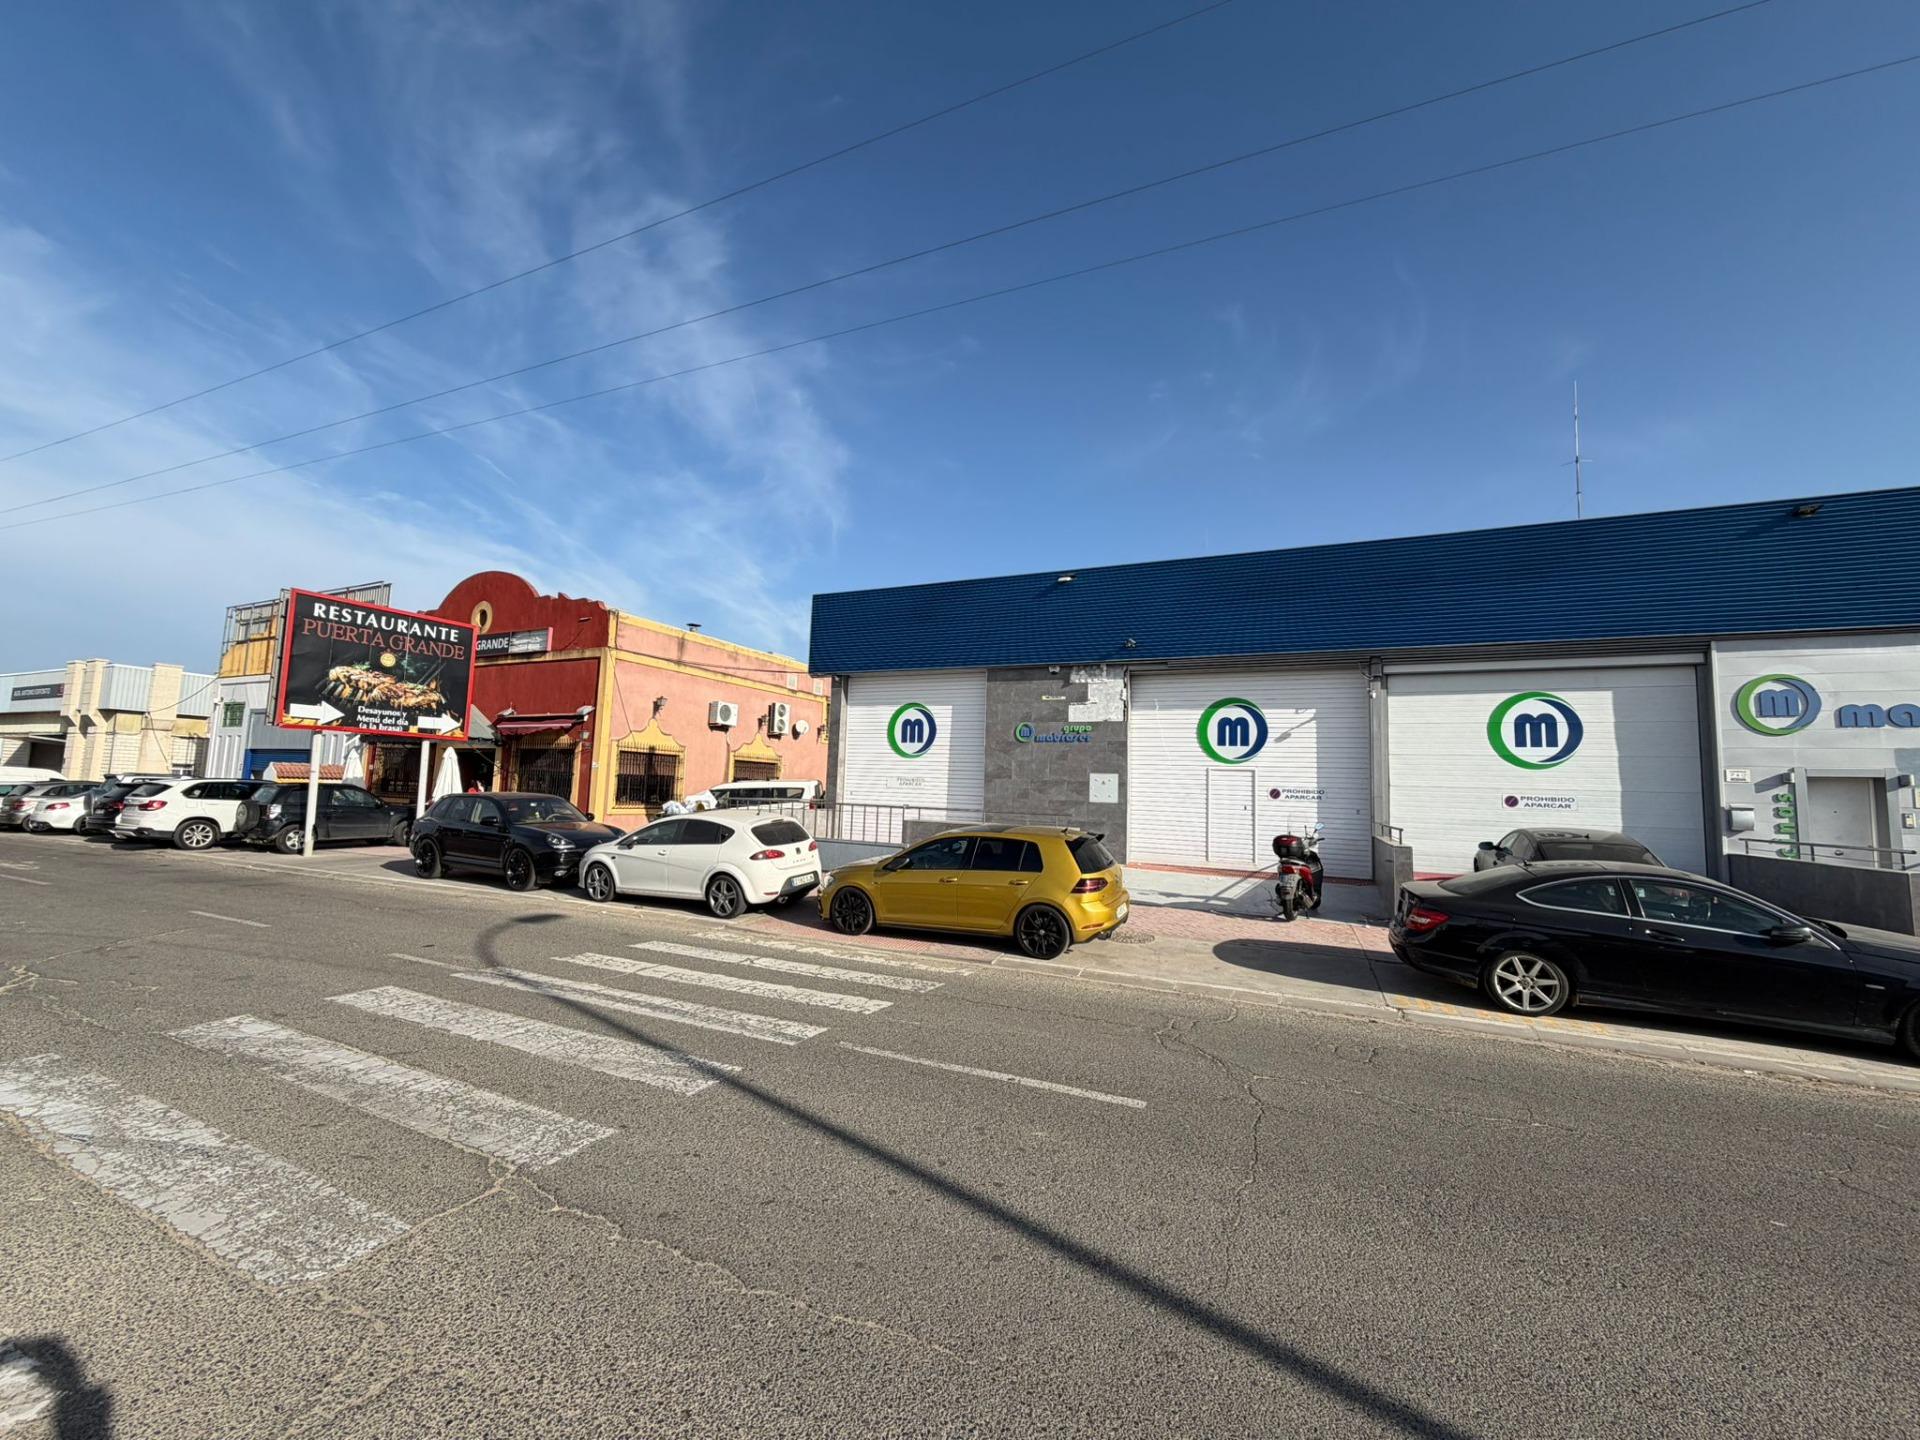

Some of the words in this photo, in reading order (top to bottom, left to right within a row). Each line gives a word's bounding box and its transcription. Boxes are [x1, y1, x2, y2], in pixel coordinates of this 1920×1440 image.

[313, 602, 460, 643] RESTAURANTE
[302, 617, 385, 648] PUERTA
[389, 634, 465, 660] GRANDE
[475, 637, 509, 650] GRANDE
[356, 714, 380, 723] Menú
[382, 716, 396, 725] del
[396, 718, 409, 726] día
[357, 705, 401, 716] Desayunos
[900, 718, 924, 743] m
[1063, 725, 1092, 733] grupo
[1217, 716, 1250, 746] m
[1513, 713, 1559, 748] m
